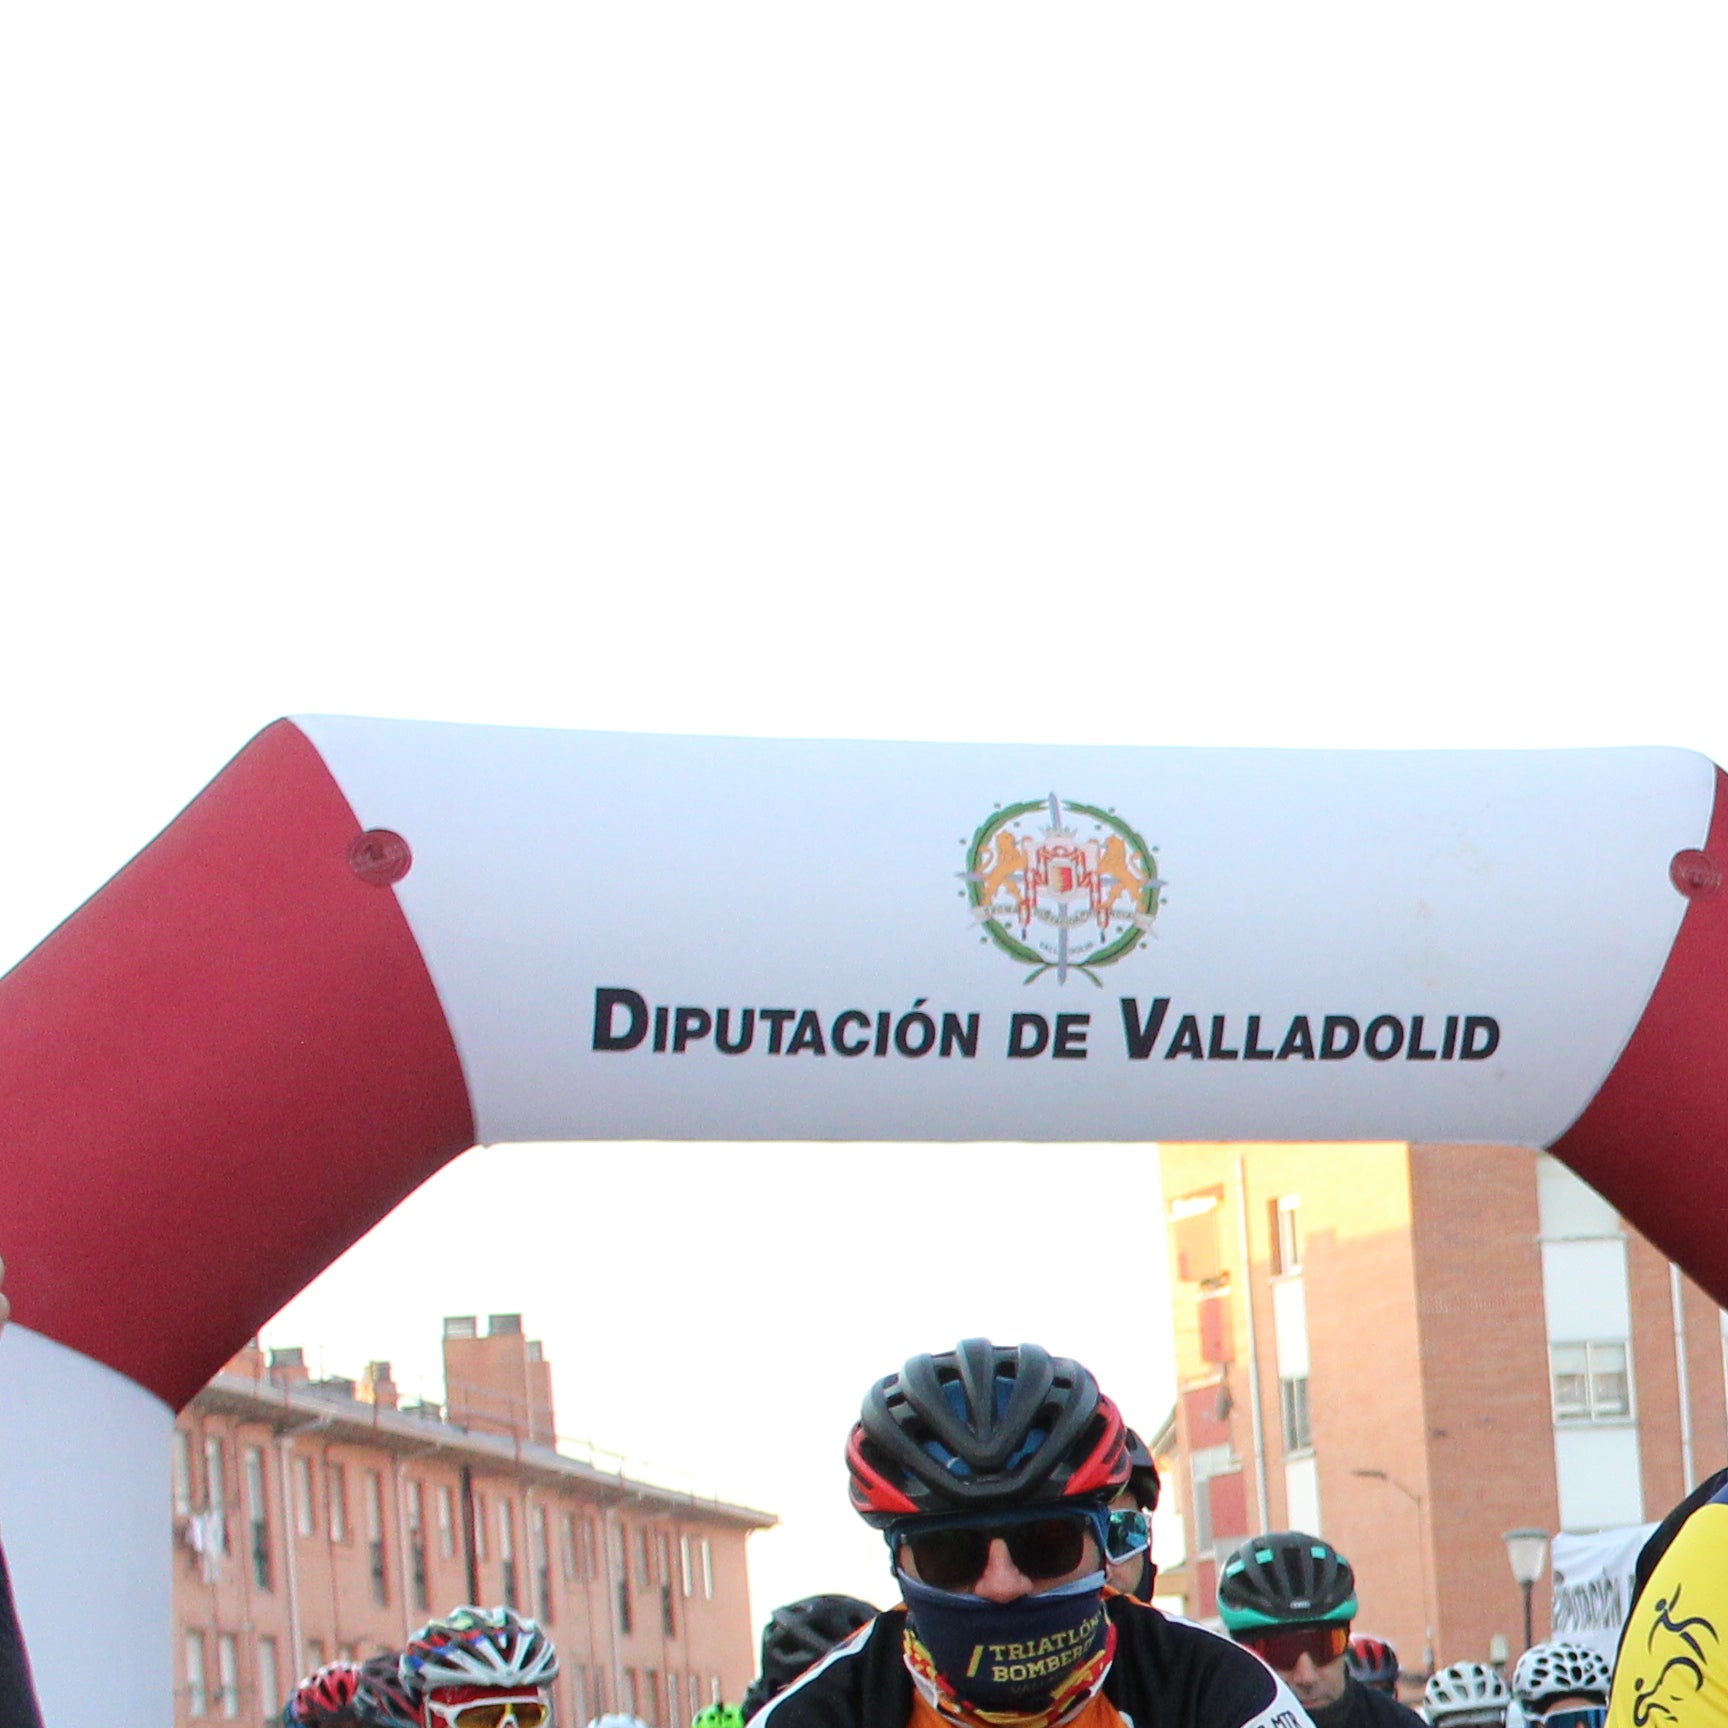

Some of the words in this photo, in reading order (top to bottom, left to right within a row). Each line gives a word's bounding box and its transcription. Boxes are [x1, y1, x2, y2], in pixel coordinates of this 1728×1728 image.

[593, 986, 980, 1058] DIPUTACIÓN
[1007, 1012, 1091, 1058] DE
[1119, 997, 1501, 1061] VALLADOLID
